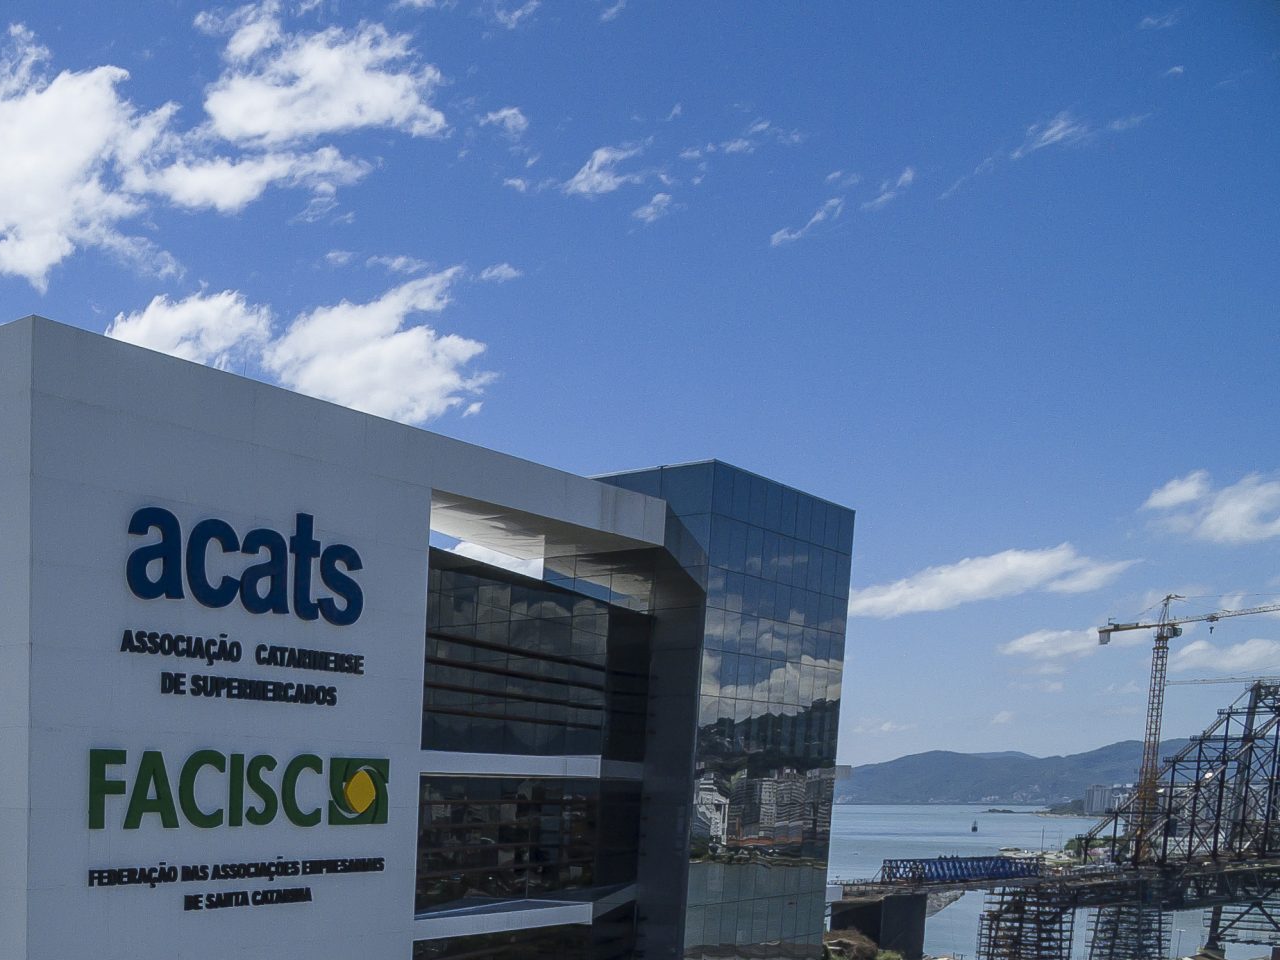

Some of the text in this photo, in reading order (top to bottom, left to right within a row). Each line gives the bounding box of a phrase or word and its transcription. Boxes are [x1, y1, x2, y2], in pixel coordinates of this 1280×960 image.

[126, 506, 364, 626] acats
[120, 630, 365, 675] ASSOCIAÇÃO CATARINENSE
[161, 672, 337, 706] DE SUPERMERCADOS
[88, 861, 178, 888] FEDERAÇÃO
[211, 856, 300, 881] ASSOCIAÇÕES
